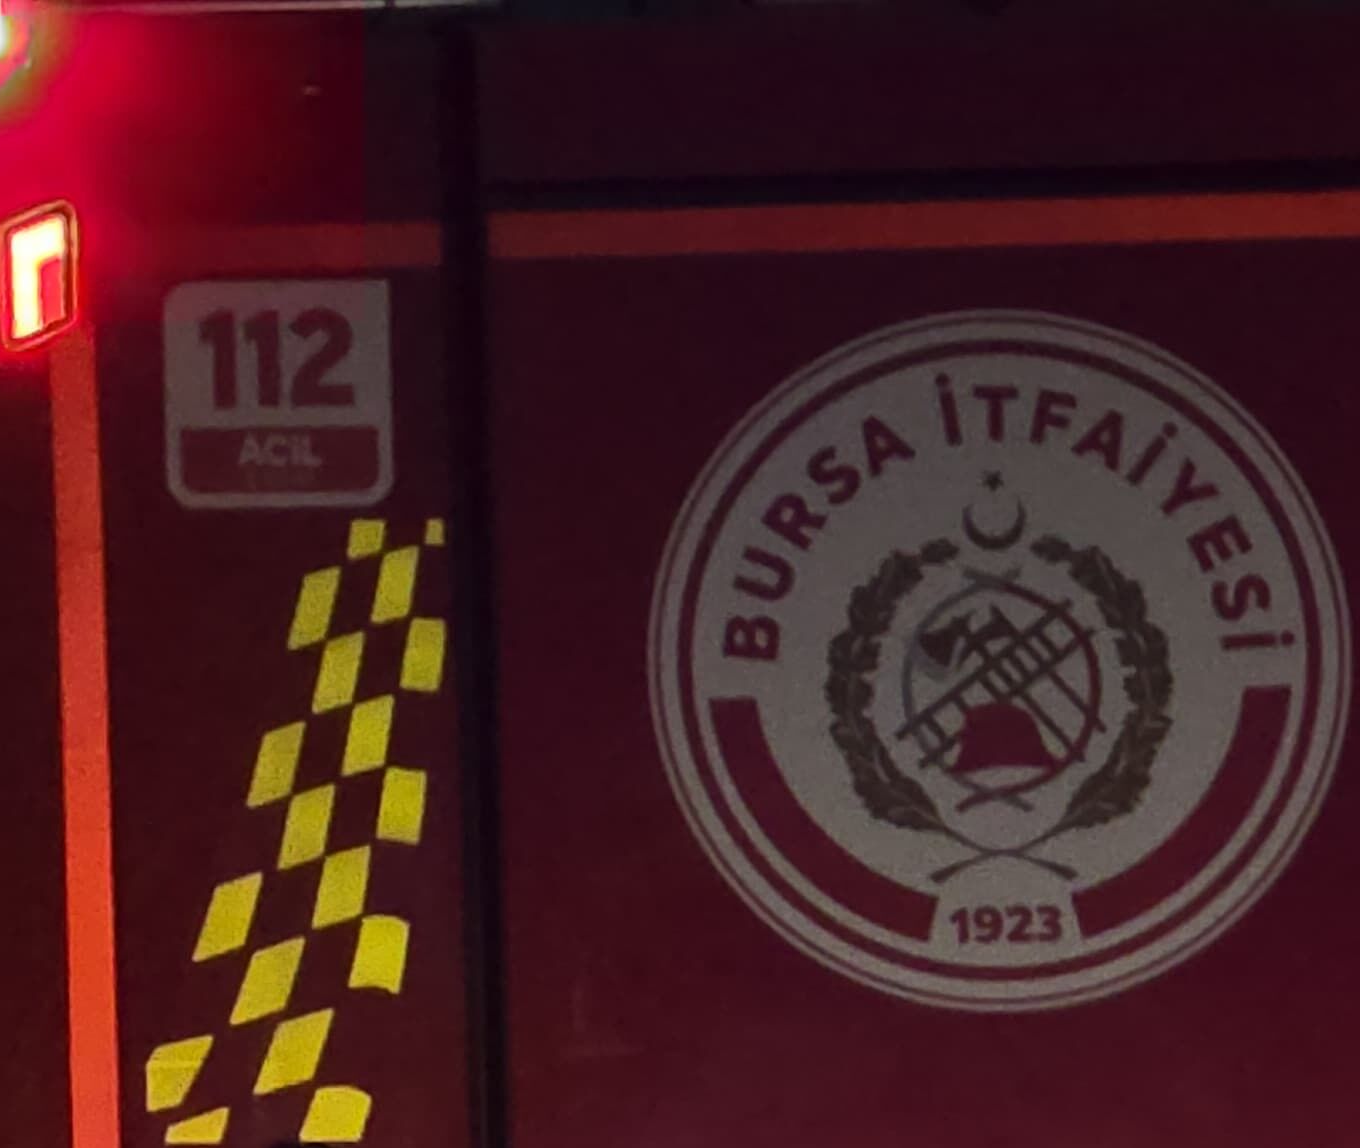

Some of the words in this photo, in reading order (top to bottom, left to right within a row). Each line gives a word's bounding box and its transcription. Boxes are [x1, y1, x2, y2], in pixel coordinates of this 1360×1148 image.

[198, 306, 356, 411] 112
[722, 415, 917, 662] BURSA
[934, 372, 1296, 652] İTFAİYESİ
[949, 905, 1063, 944] 1923
